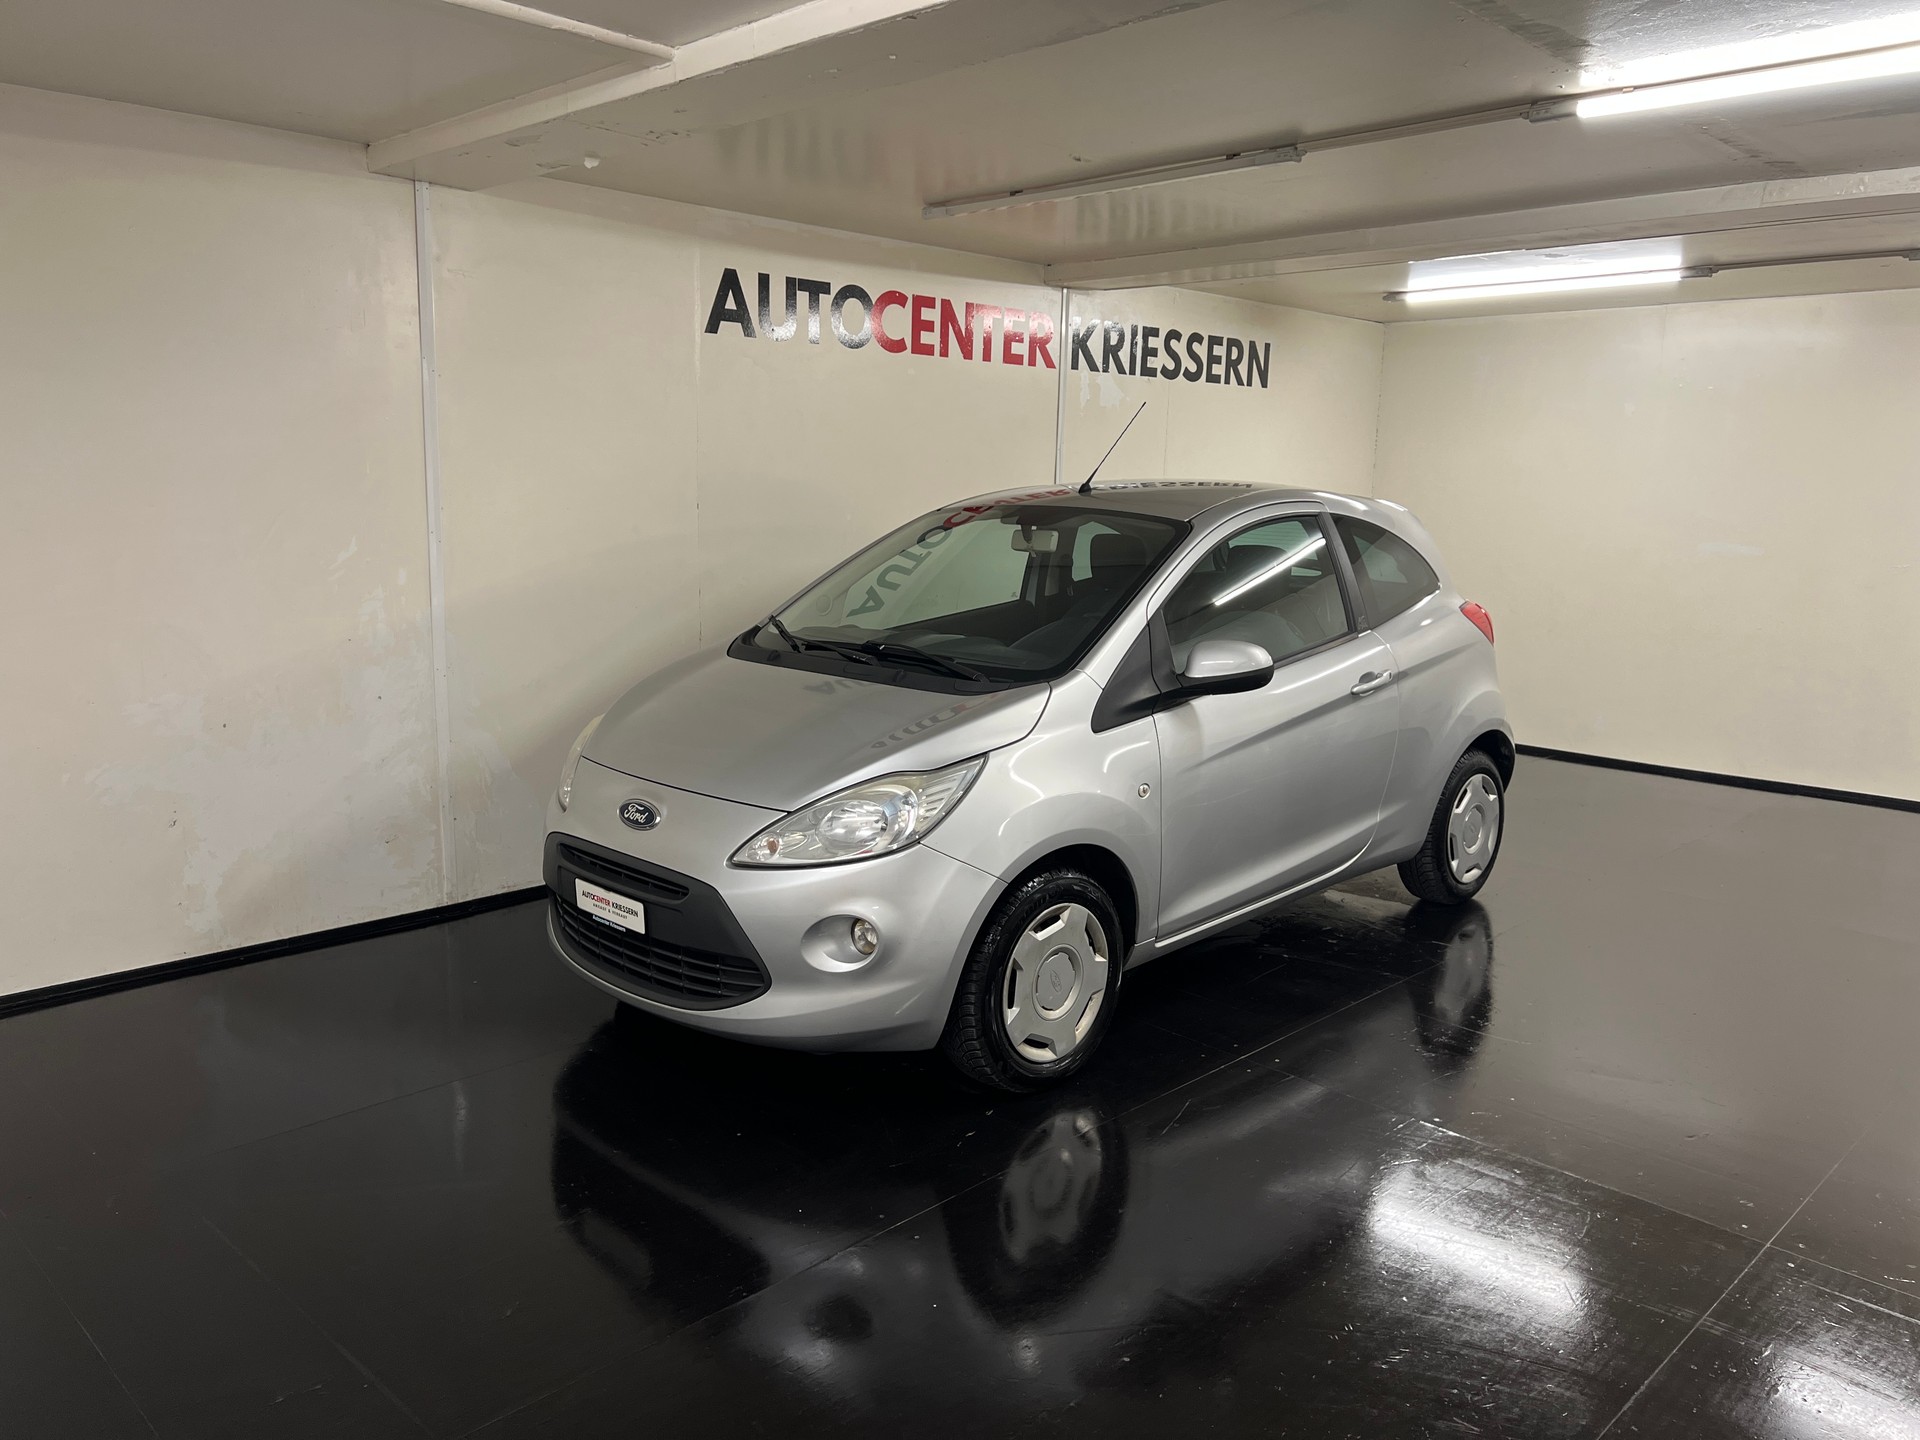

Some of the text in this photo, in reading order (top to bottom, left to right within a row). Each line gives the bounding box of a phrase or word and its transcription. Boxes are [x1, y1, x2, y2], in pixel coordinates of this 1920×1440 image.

[704, 267, 1272, 389] AUTOCENTER KRIESSERN
[624, 803, 649, 823] Ford
[582, 890, 639, 917] AUTOCENTER KRIESSERN
